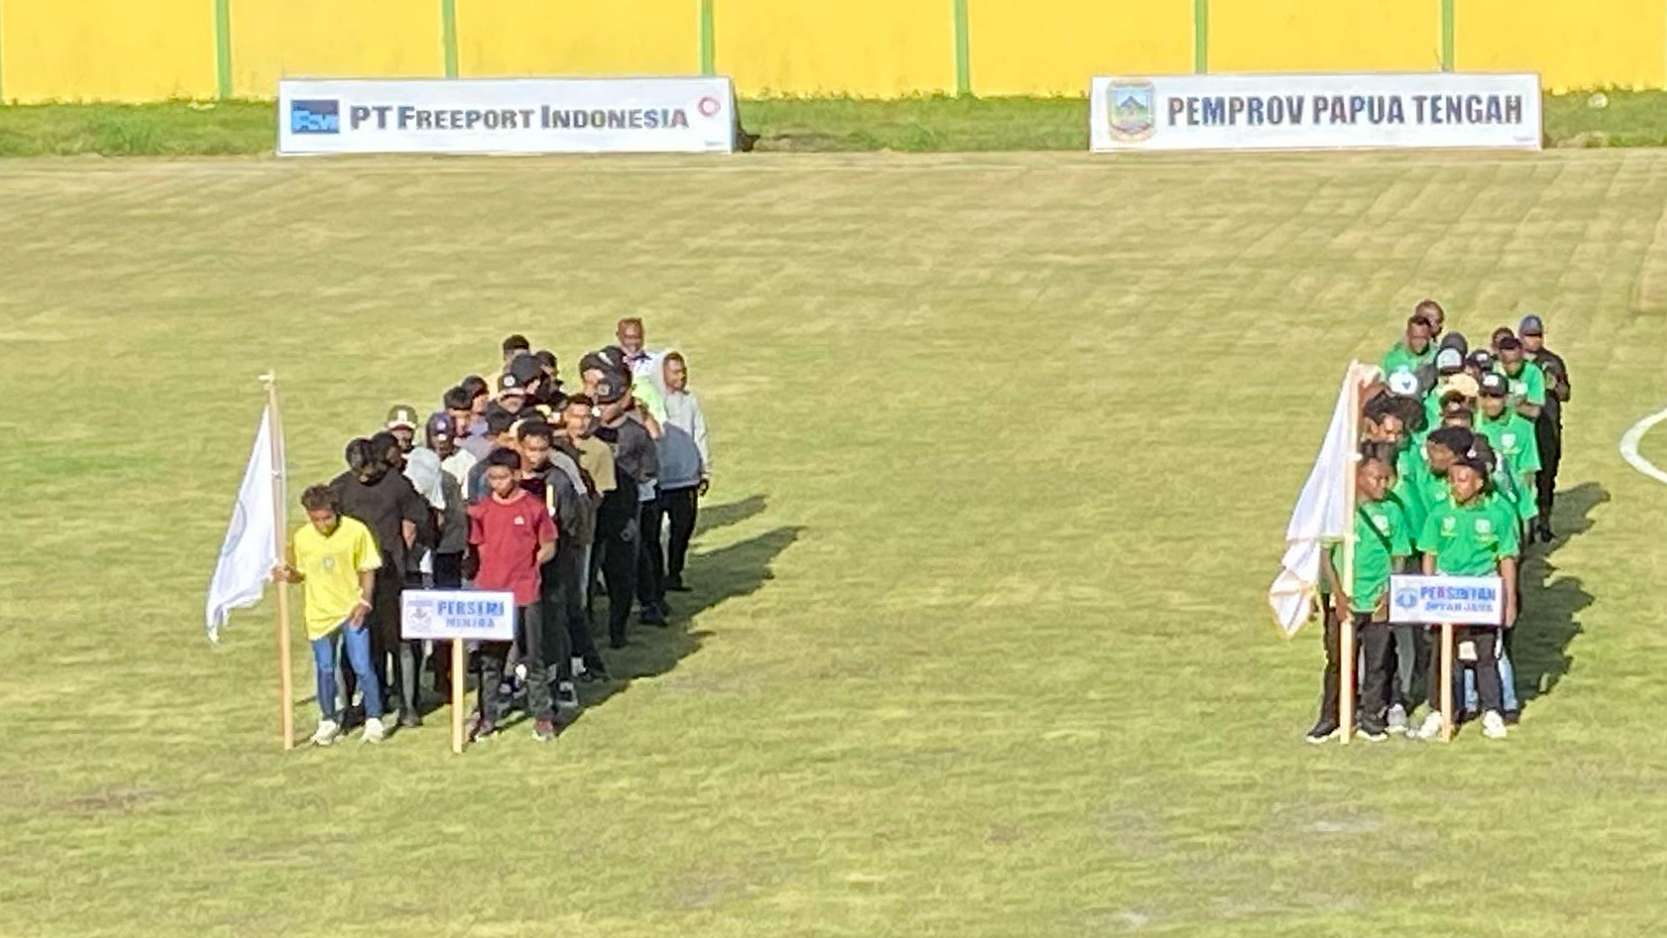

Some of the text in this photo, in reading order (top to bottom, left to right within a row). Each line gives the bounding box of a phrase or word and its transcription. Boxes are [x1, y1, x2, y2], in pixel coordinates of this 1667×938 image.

[350, 105, 689, 130] PT FREEPORT INDONESIA
[1167, 94, 1523, 126] PEMPROV PAPUA TENGAH
